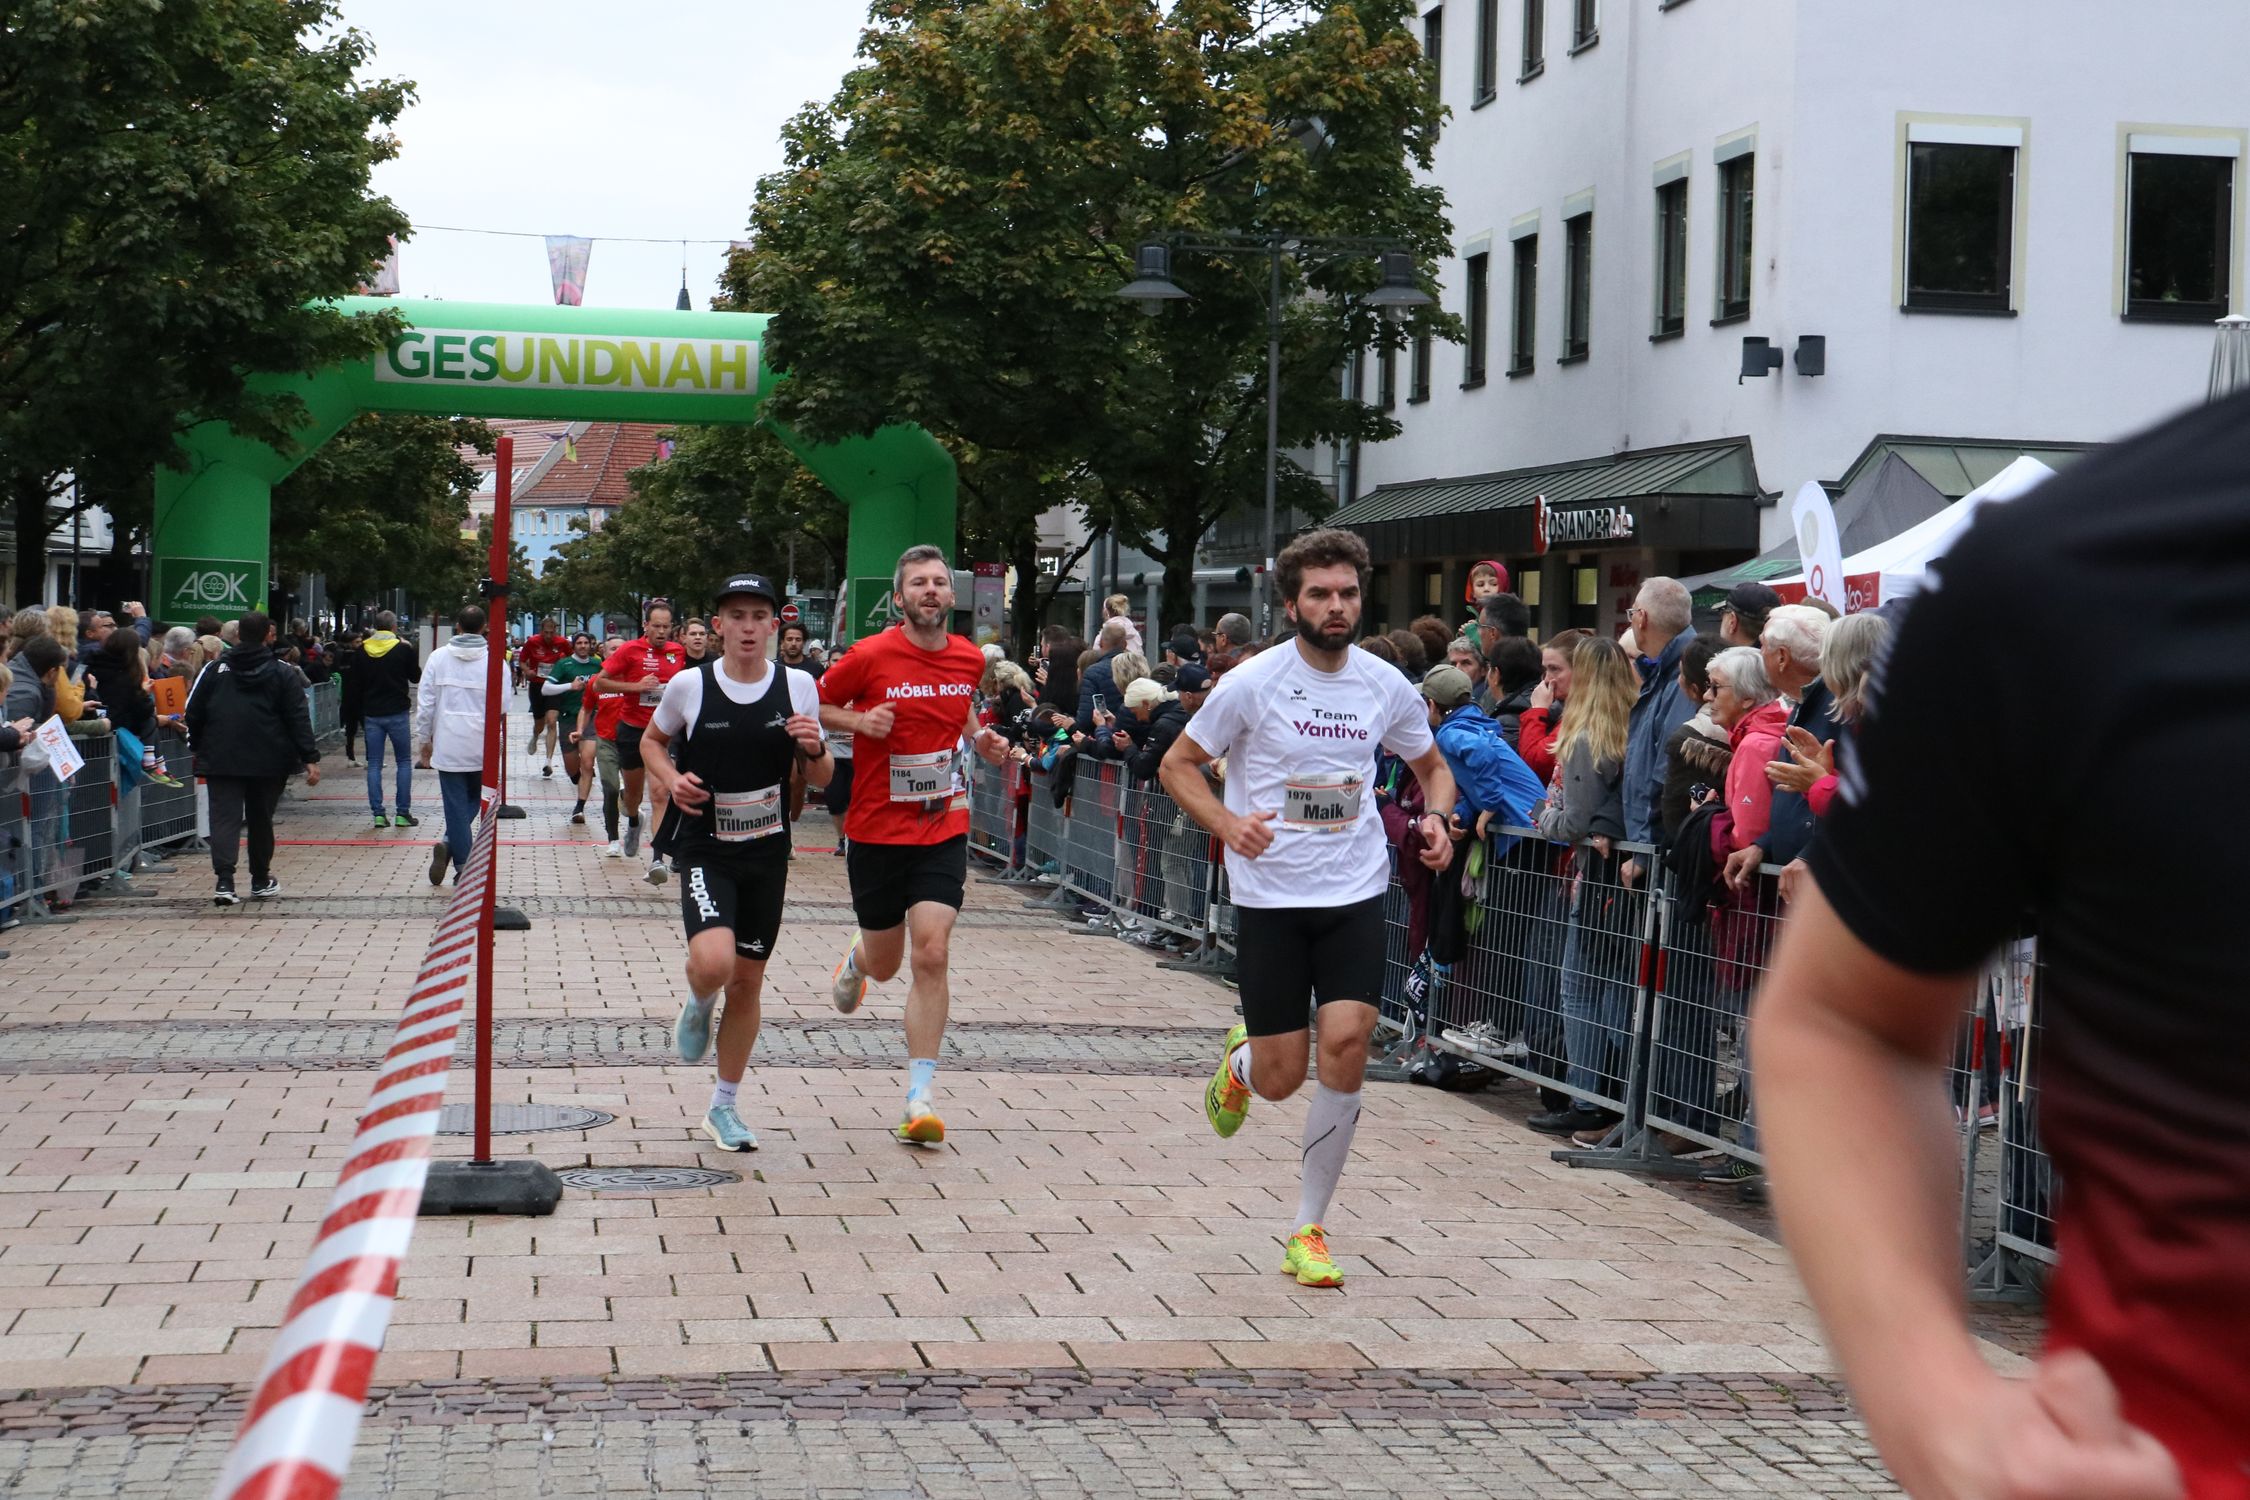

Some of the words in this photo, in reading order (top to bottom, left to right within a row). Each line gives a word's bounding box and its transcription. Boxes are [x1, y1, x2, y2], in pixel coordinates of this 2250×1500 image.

[387, 332, 748, 391] GESUNDNAH
[174, 571, 249, 603] AOK
[886, 682, 937, 699] MÖBEL
[1311, 708, 1358, 721] Team
[1293, 720, 1368, 741] Vantive
[891, 769, 911, 778] 1184
[907, 780, 937, 792] Tom
[1287, 789, 1312, 801] 1976
[1303, 803, 1345, 820] Maik
[718, 813, 777, 832] Tillmann
